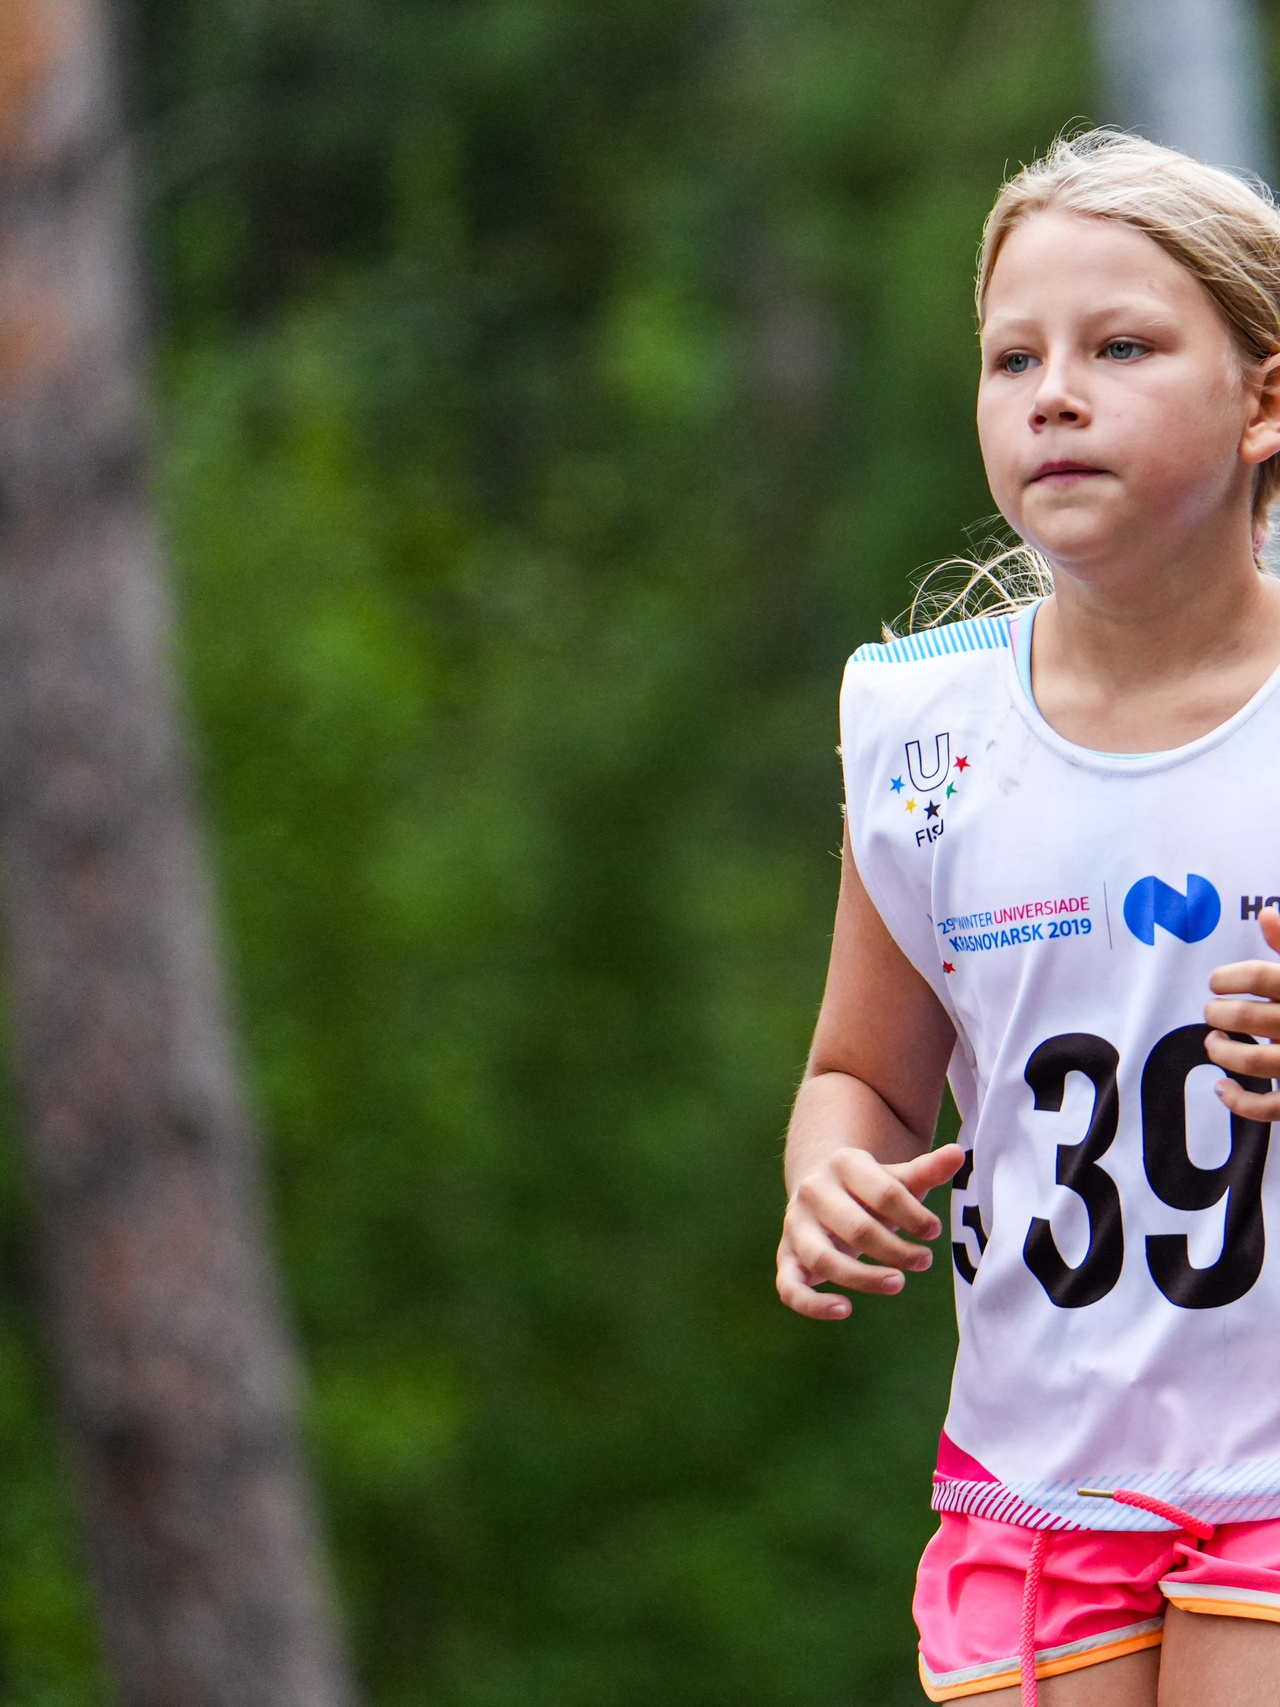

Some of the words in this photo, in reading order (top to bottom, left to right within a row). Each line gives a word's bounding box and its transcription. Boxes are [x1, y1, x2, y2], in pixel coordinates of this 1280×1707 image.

[993, 896, 1090, 925] UNIVERSIADE
[1048, 917, 1092, 940] 2019
[1023, 1022, 1273, 1310] 39
